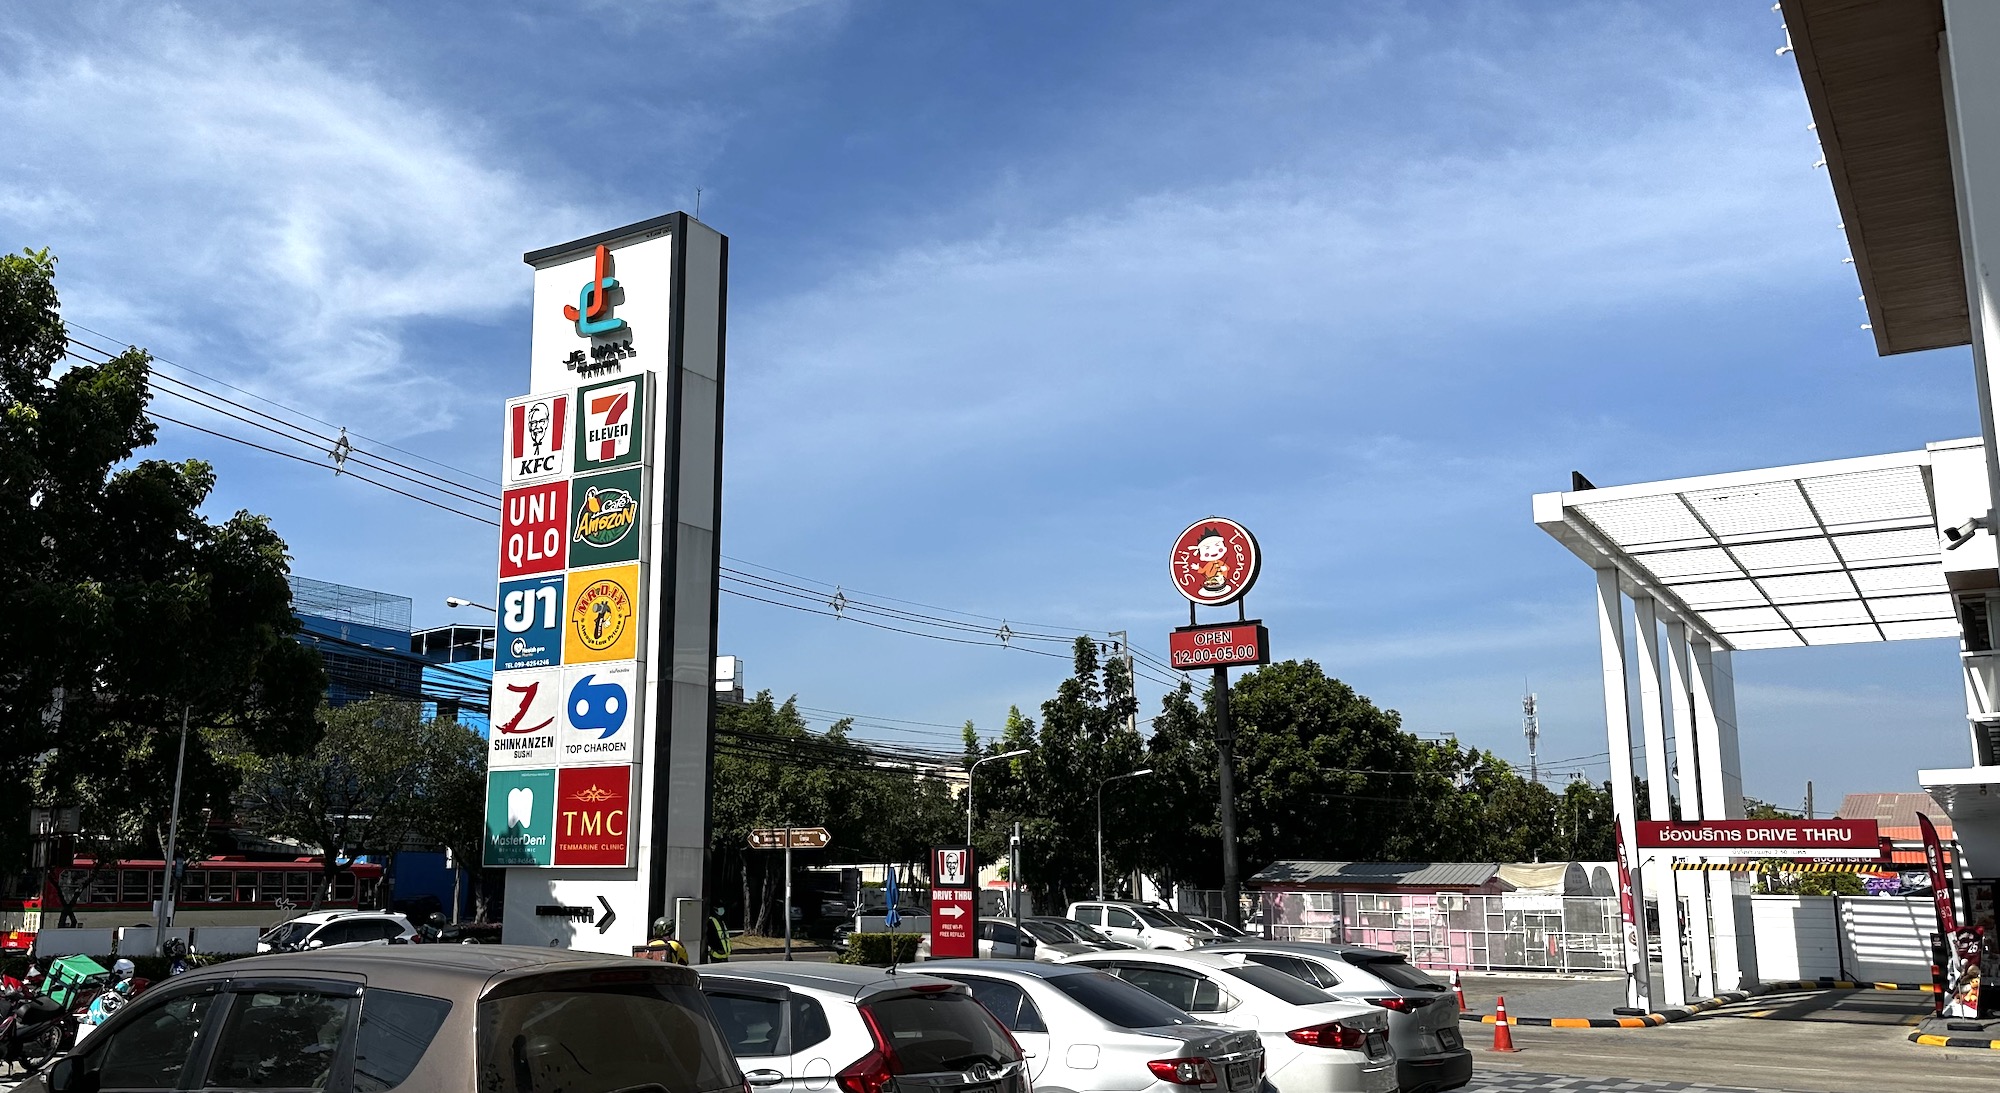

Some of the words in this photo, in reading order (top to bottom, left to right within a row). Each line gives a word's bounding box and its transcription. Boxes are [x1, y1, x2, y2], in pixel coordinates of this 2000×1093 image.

[519, 455, 555, 475] KFC
[509, 491, 557, 527] UNI
[508, 527, 560, 568] QLO
[1173, 550, 1196, 586] Suki
[503, 585, 557, 633] ยา
[1194, 630, 1232, 646] OPEN
[1173, 645, 1255, 665] 12.00-05.00
[494, 736, 554, 751] SHINKANZEN
[566, 744, 582, 754] TOP
[583, 742, 627, 753] CHAROEN
[513, 750, 533, 759] SUSHI
[562, 809, 624, 836] TMC
[491, 833, 547, 846] MasterDent
[1658, 825, 1742, 842] ช่องบริการ
[1746, 828, 1798, 842] DRIVE
[1802, 828, 1852, 842] THRU
[559, 843, 599, 851] TEMMARINE
[600, 843, 625, 851] CLINIC
[932, 890, 953, 901] DRIVE
[954, 890, 973, 901] THRU
